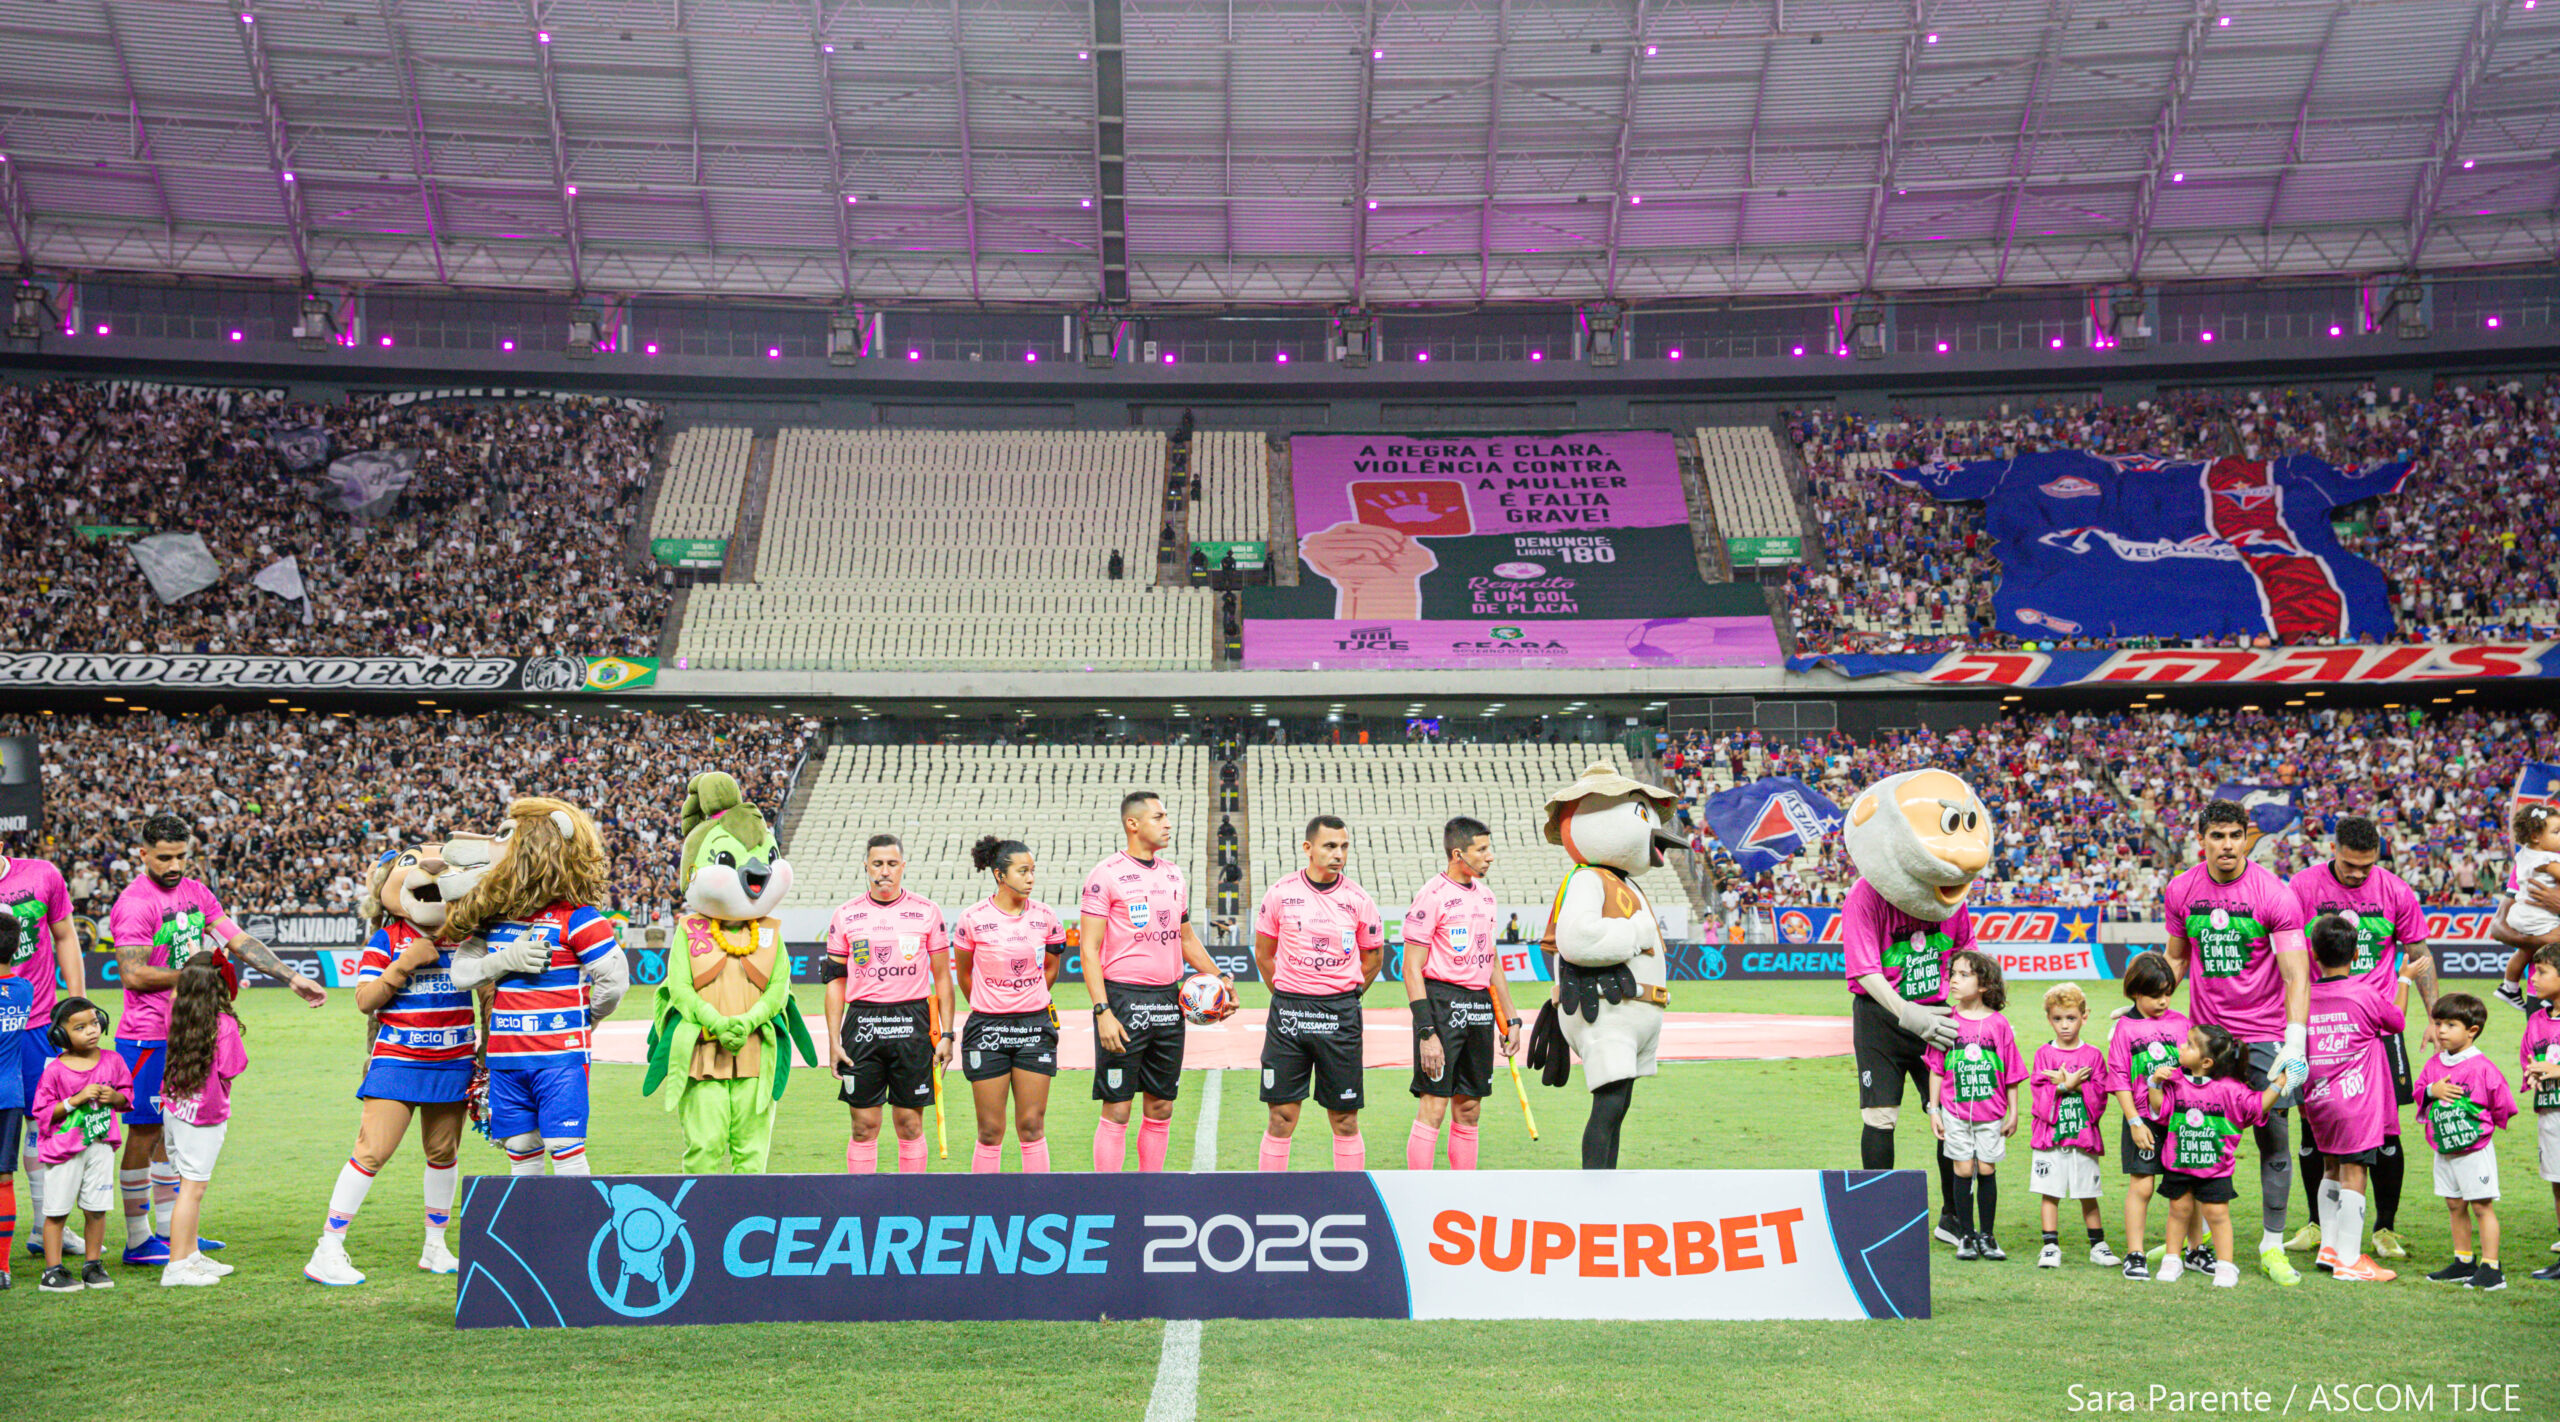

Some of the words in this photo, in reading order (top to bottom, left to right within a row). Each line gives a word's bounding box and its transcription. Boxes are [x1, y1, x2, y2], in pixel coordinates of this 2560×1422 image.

[1359, 445, 1377, 457] A
[1387, 445, 1477, 457] REGRA
[1487, 443, 1504, 457] É
[1514, 444, 1612, 457] CLARA.
[1353, 459, 1503, 474] VIOLÊNCIA
[1512, 459, 1622, 474] CONTRA
[1477, 478, 1496, 490] A
[1506, 476, 1628, 490] MULHER
[1500, 492, 1516, 507] É
[1528, 493, 1611, 507] FALTA
[1506, 508, 1611, 523] GRAVE!
[1514, 536, 1612, 548] DENUNCIE:
[1516, 548, 1556, 556] LIGUE
[1557, 546, 1616, 564] 180
[1468, 576, 1576, 593] Respeito
[1474, 587, 1488, 602] É
[1494, 591, 1527, 602] UM
[1533, 590, 1575, 602] GOL
[1472, 603, 1500, 614] DE
[1506, 603, 1580, 614] PLACA!
[1333, 640, 1411, 651] TJCE
[1451, 638, 1569, 649] CEARÁ
[54, 656, 509, 686] INDEPENDENTE
[1130, 903, 1148, 912] FIFA
[1450, 927, 1467, 936] FIFA
[2200, 928, 2242, 946] Respeito
[1905, 946, 1940, 969] Respeito
[2203, 944, 2210, 958] É
[2211, 945, 2223, 958] UM
[2224, 945, 2241, 958] GOL
[1742, 952, 1845, 972] CEARENS
[2205, 960, 2216, 972] DE
[2216, 959, 2243, 972] PLACA!
[415, 973, 452, 983] RESEN
[855, 963, 917, 982] evogard
[1914, 967, 1925, 981] UM
[1925, 964, 1940, 978] GOL
[415, 983, 431, 993] DA
[432, 981, 457, 992] SOR
[1906, 982, 1918, 996] DE
[882, 1015, 901, 1023] Honda
[1304, 1010, 1325, 1019] Honda
[2310, 1012, 2348, 1024] RESPEITO
[873, 1025, 914, 1035] NOSSAMOTO
[1009, 1026, 1028, 1034] Honda
[1297, 1020, 1340, 1031] NOSSAMOTO
[2316, 1023, 2361, 1035] MULHERES
[407, 1031, 442, 1045] tecla
[999, 1035, 1041, 1045] NOSSAMOTO
[1957, 1060, 1993, 1075] Respeito
[1960, 1071, 1966, 1085] É
[1966, 1073, 1978, 1085] UM
[1978, 1073, 1991, 1085] GOL
[1961, 1086, 1971, 1097] DE
[2338, 1073, 2366, 1099] 180
[2537, 1094, 2548, 1106] DE
[2064, 1107, 2077, 1120] UM
[94, 1123, 106, 1136] UM
[2179, 1124, 2216, 1140] Respeito
[2444, 1122, 2457, 1135] UM
[2457, 1118, 2474, 1131] GOL
[2181, 1139, 2186, 1151] É
[2186, 1140, 2199, 1151] UM
[2199, 1140, 2215, 1151] GOL
[2442, 1137, 2454, 1150] DE
[2180, 1152, 2191, 1164] DE
[2191, 1152, 2217, 1164] PLACA!
[722, 1213, 1116, 1279] CEARENSE
[1143, 1213, 1369, 1274] 2026
[1428, 1207, 1804, 1278] SUPERBET
